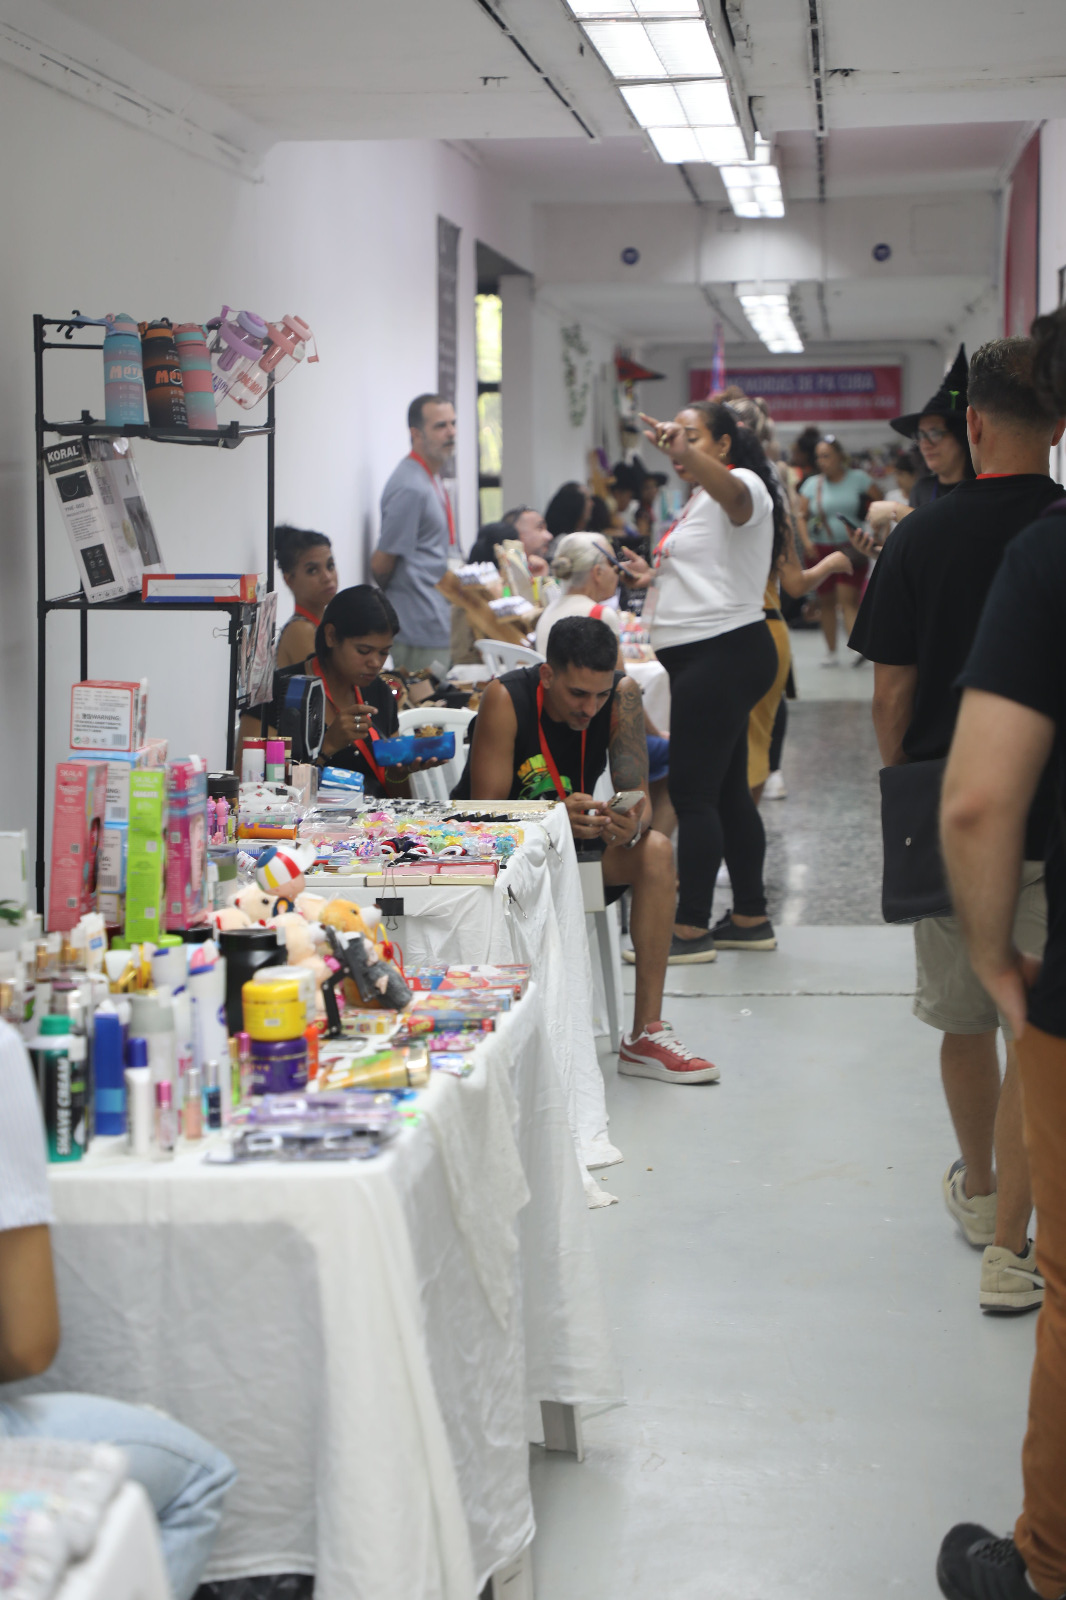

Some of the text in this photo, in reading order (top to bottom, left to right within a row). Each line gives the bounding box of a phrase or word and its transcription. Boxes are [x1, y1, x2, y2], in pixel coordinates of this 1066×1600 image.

[47, 445, 79, 462] KORAL
[59, 769, 83, 778] SKALA
[57, 1057, 72, 1156] SHAVE CREAM
